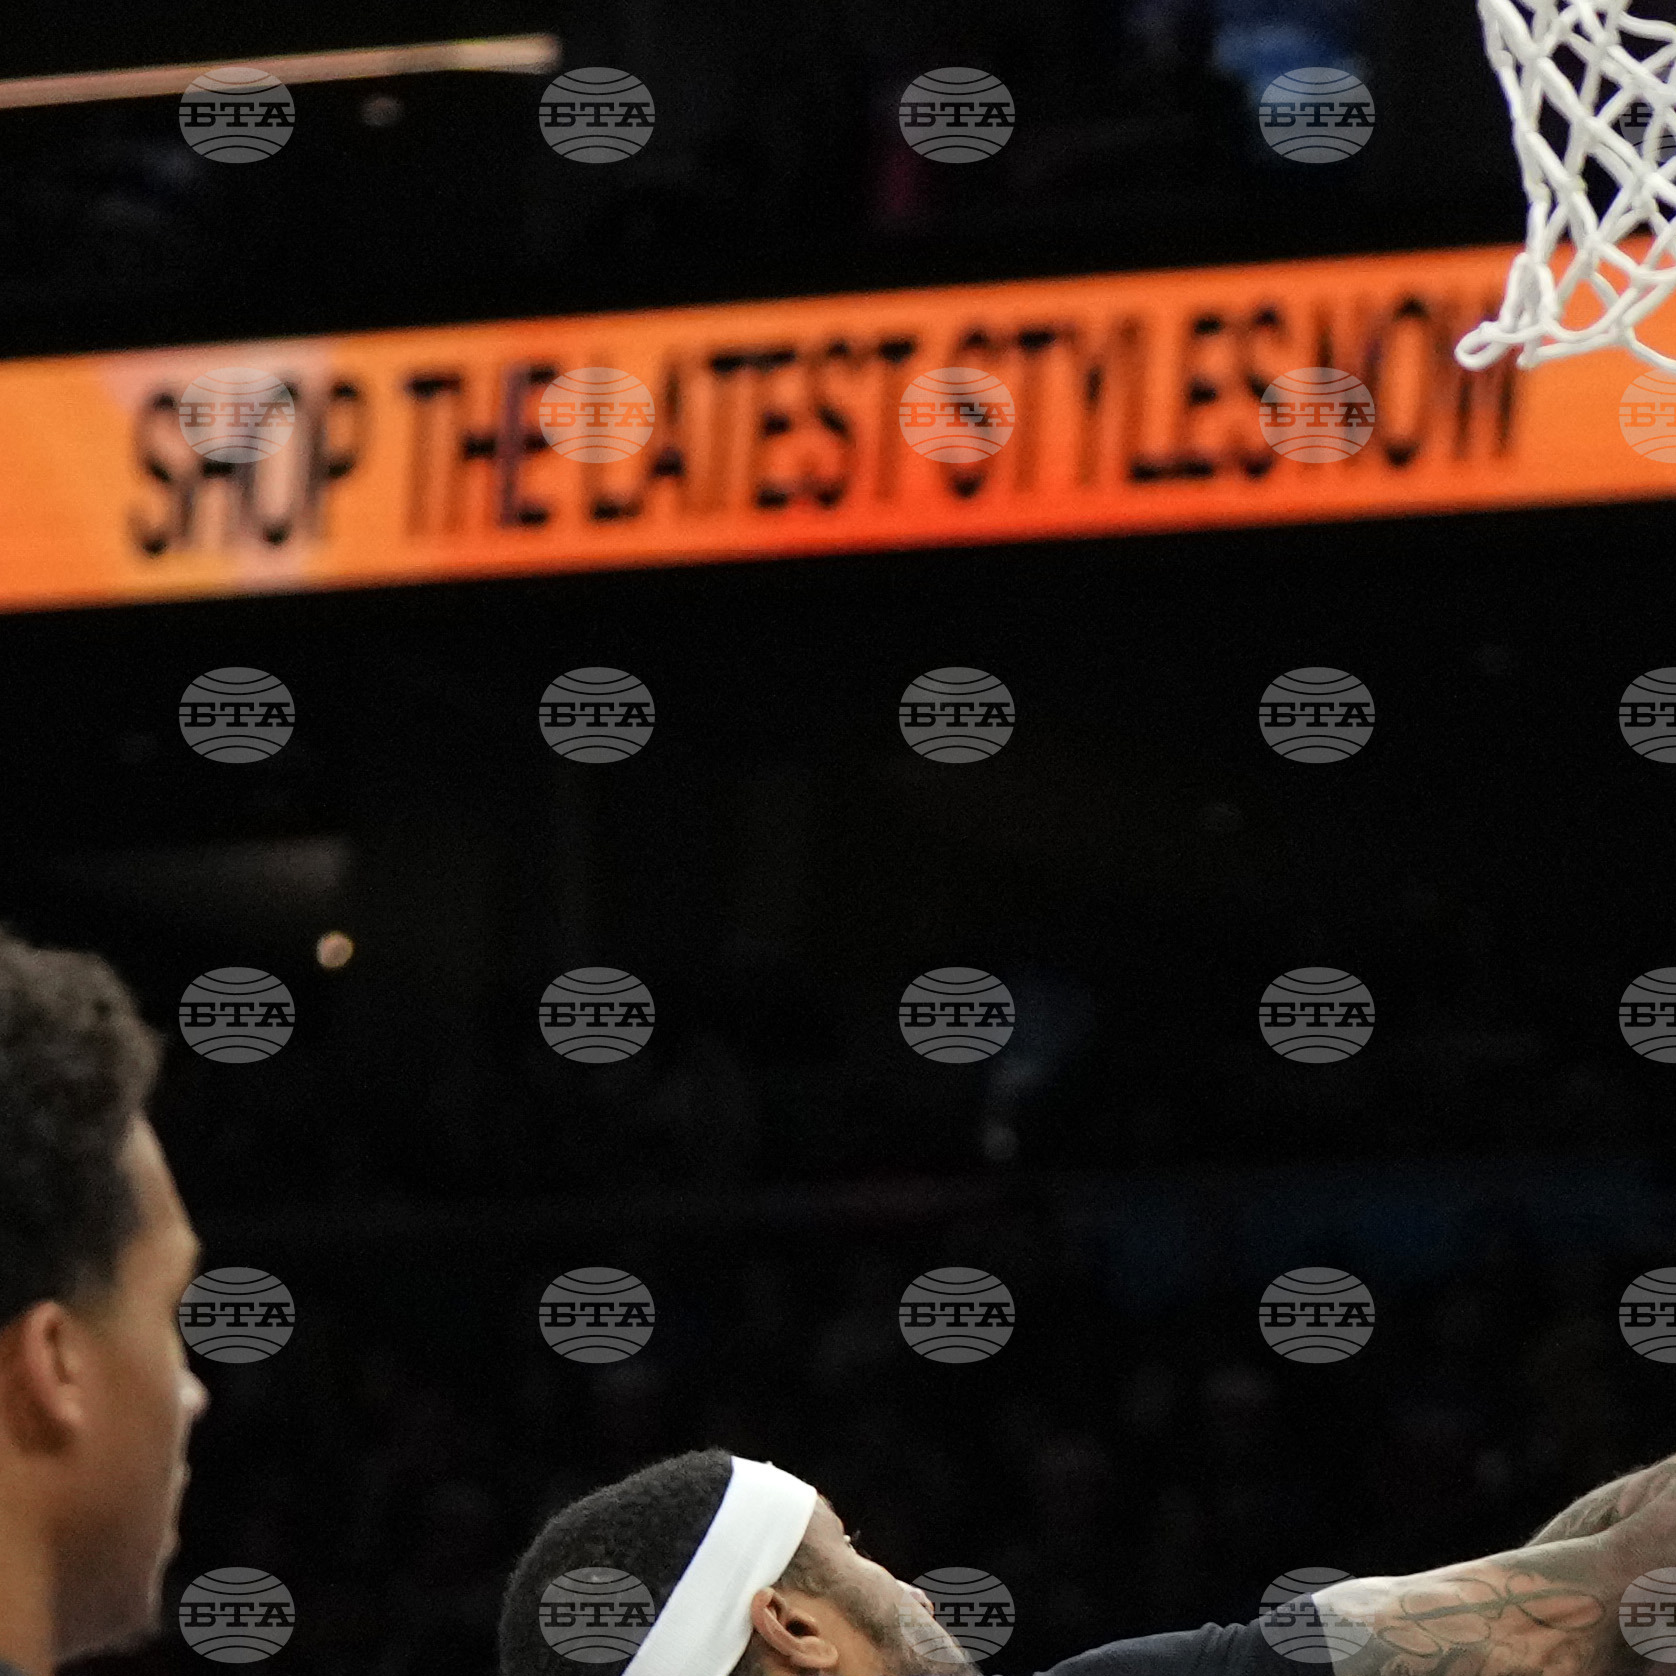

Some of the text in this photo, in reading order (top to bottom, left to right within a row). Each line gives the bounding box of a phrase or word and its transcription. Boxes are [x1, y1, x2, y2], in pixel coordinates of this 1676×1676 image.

[130, 373, 364, 558] SHOP
[405, 362, 560, 541] THE
[590, 335, 917, 522] LATEST
[945, 307, 1284, 500] STYLES
